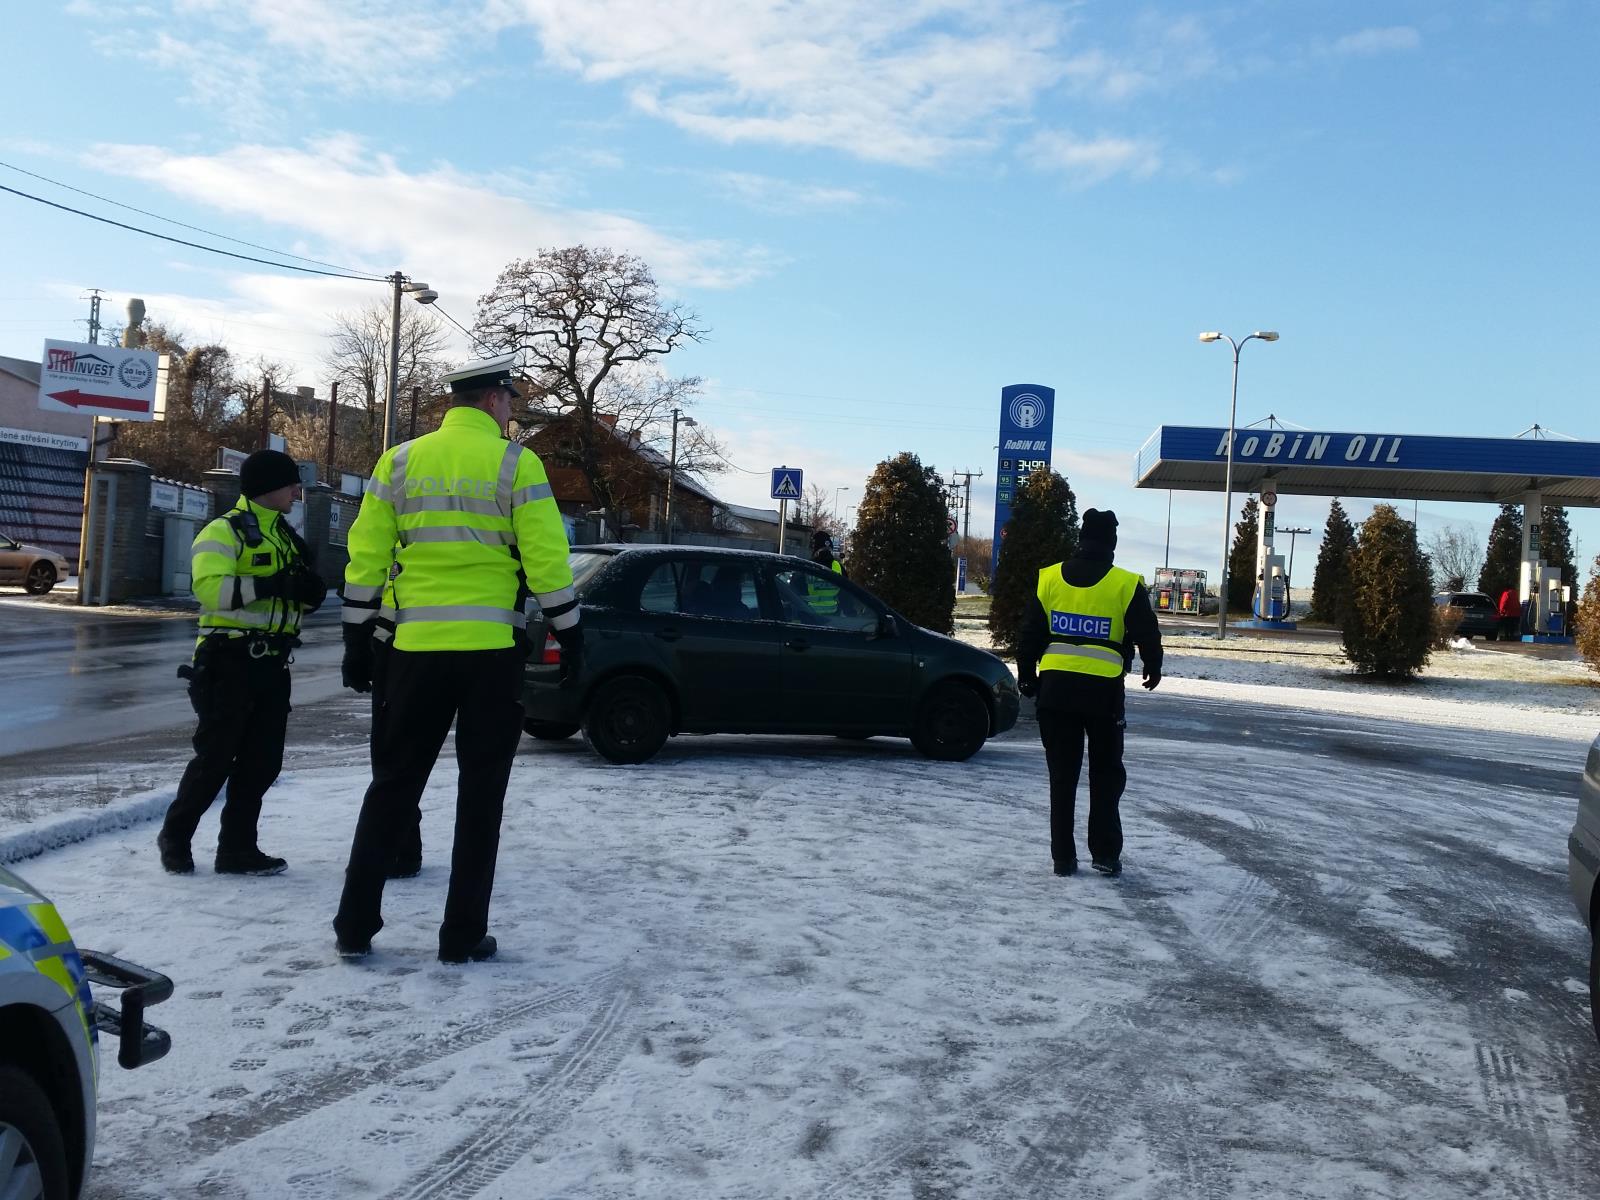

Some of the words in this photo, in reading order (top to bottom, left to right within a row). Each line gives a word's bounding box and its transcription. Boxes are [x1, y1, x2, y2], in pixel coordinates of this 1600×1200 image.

[0, 430, 19, 440] lené
[51, 436, 80, 449] krytiny
[1032, 440, 1047, 451] OIL
[1344, 434, 1402, 463] OIL
[405, 476, 497, 497] POLICIE
[1052, 614, 1110, 635] POLICIE
